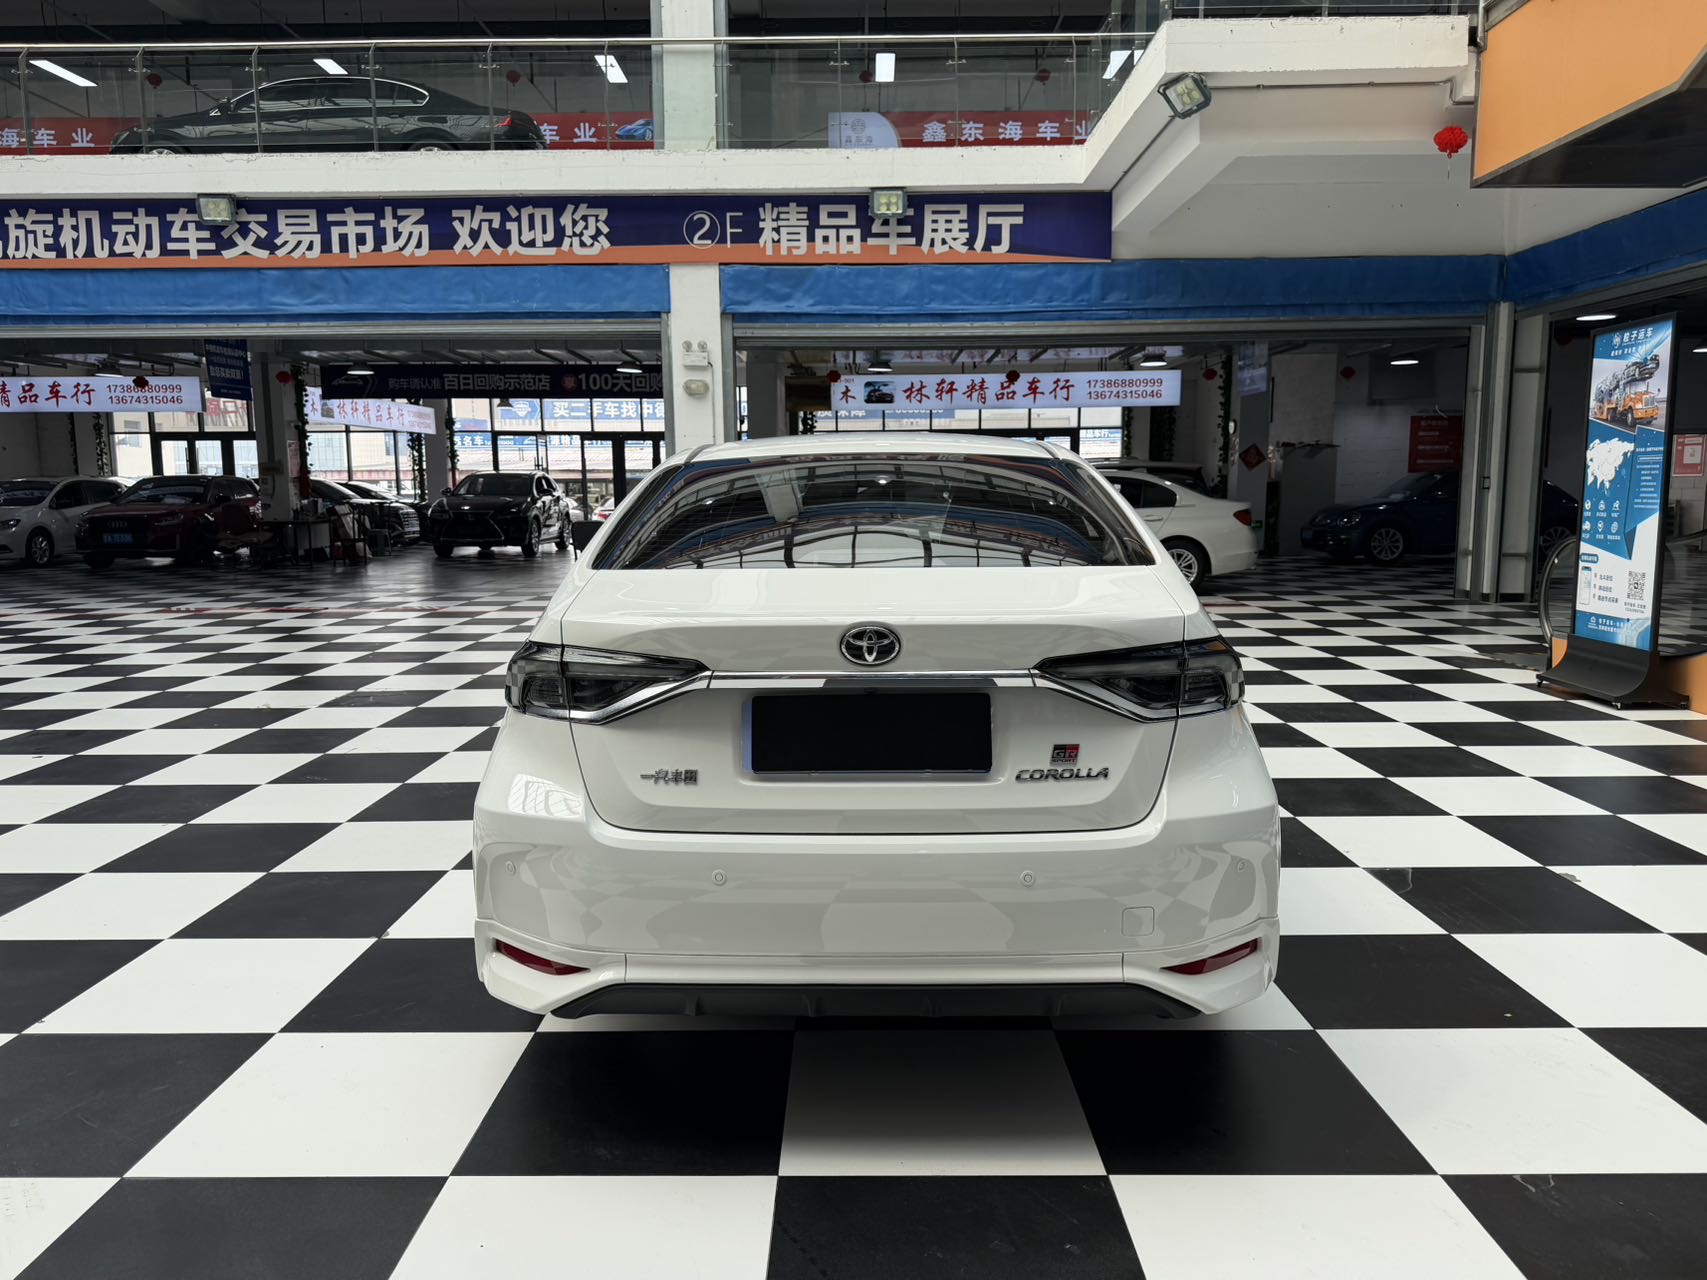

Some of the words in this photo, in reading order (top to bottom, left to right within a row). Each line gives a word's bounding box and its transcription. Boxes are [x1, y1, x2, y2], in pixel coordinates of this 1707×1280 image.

[0, 205, 430, 260] 旋机动车交易市场
[452, 203, 611, 257] 欢迎您
[758, 202, 1025, 256] 精品车展厅
[443, 373, 551, 391] 百日回购示范店
[1086, 378, 1163, 389] 17386880999
[840, 385, 857, 404] 木
[902, 376, 1076, 405] 林轩精品车行
[1086, 389, 1163, 400] 13674315046
[108, 395, 183, 405] 13674315046
[1053, 749, 1078, 758] GR
[1015, 768, 1110, 782] COROLLA
